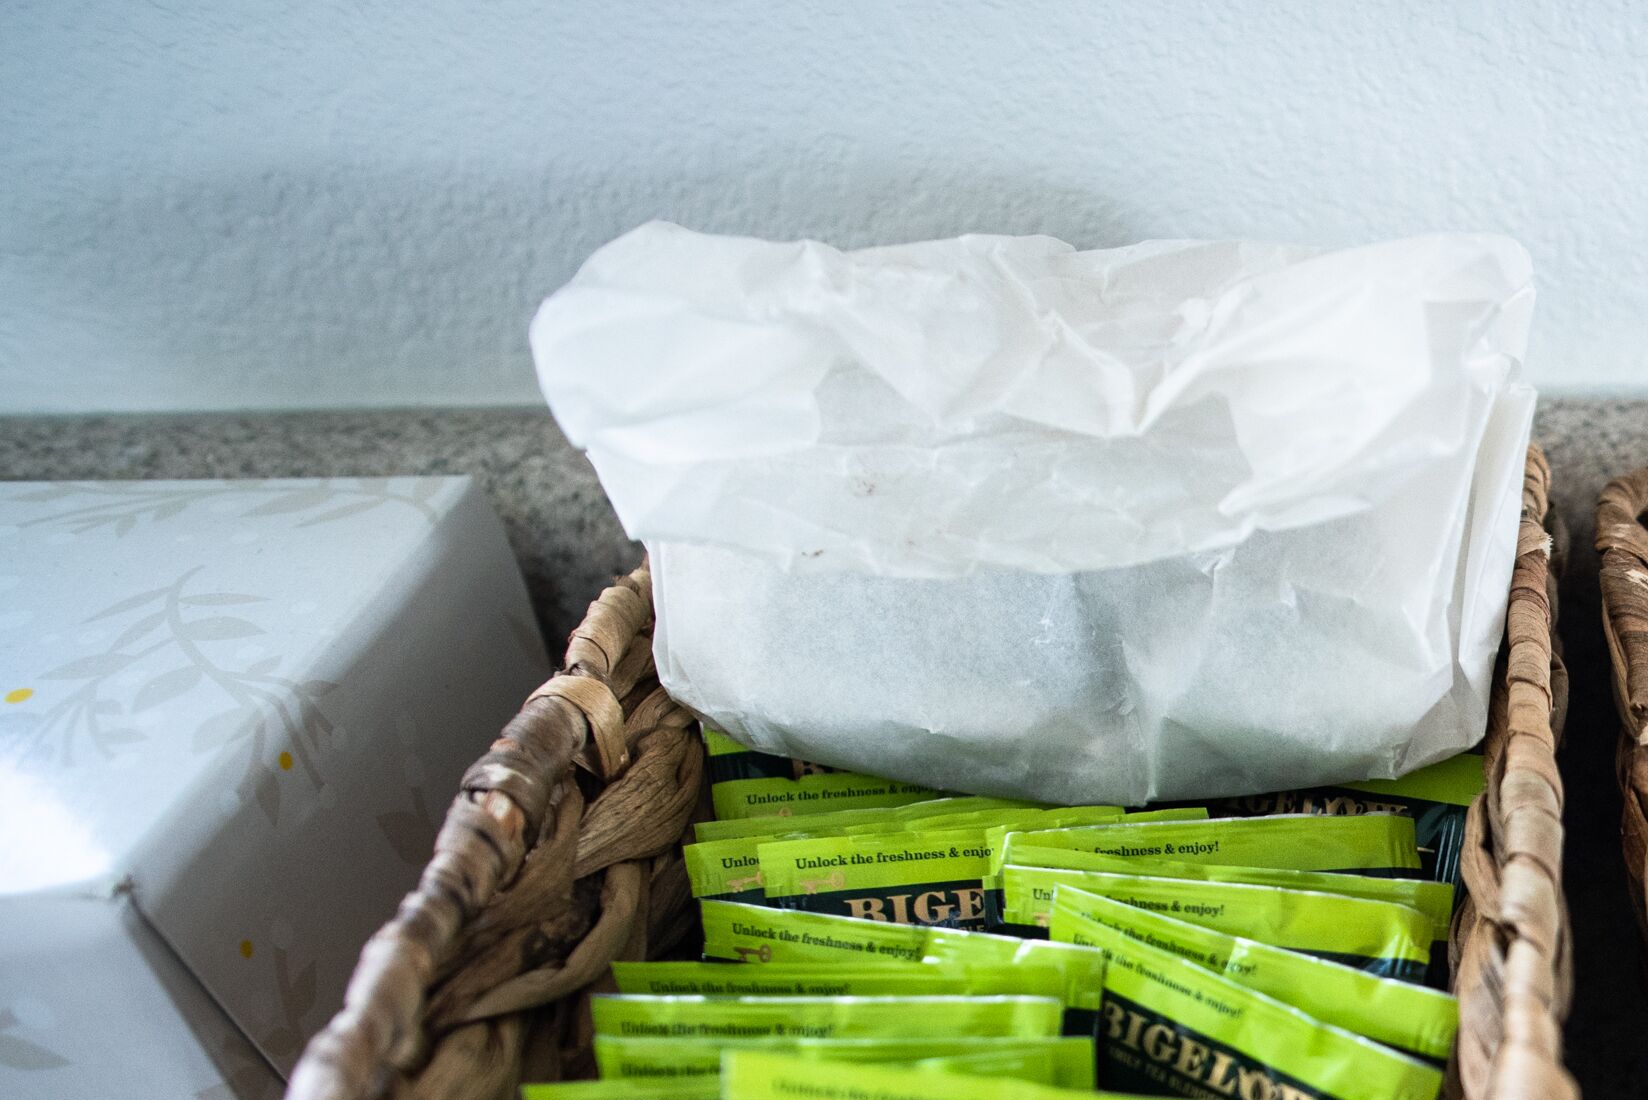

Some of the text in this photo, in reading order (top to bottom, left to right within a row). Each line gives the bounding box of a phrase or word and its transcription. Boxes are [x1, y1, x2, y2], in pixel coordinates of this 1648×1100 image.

[746, 792, 795, 805] Unlock
[797, 789, 819, 801] the
[821, 785, 886, 799] freshness
[888, 783, 898, 794] &
[795, 845, 994, 870] Unlock the freshness & enjo
[1164, 844, 1175, 855] &
[1178, 840, 1220, 856] enjoy!
[844, 887, 986, 925] BIGE
[1170, 901, 1182, 913] &
[1184, 902, 1225, 917] enjoy!
[732, 922, 922, 960] Unlock the freshness & enjoy!
